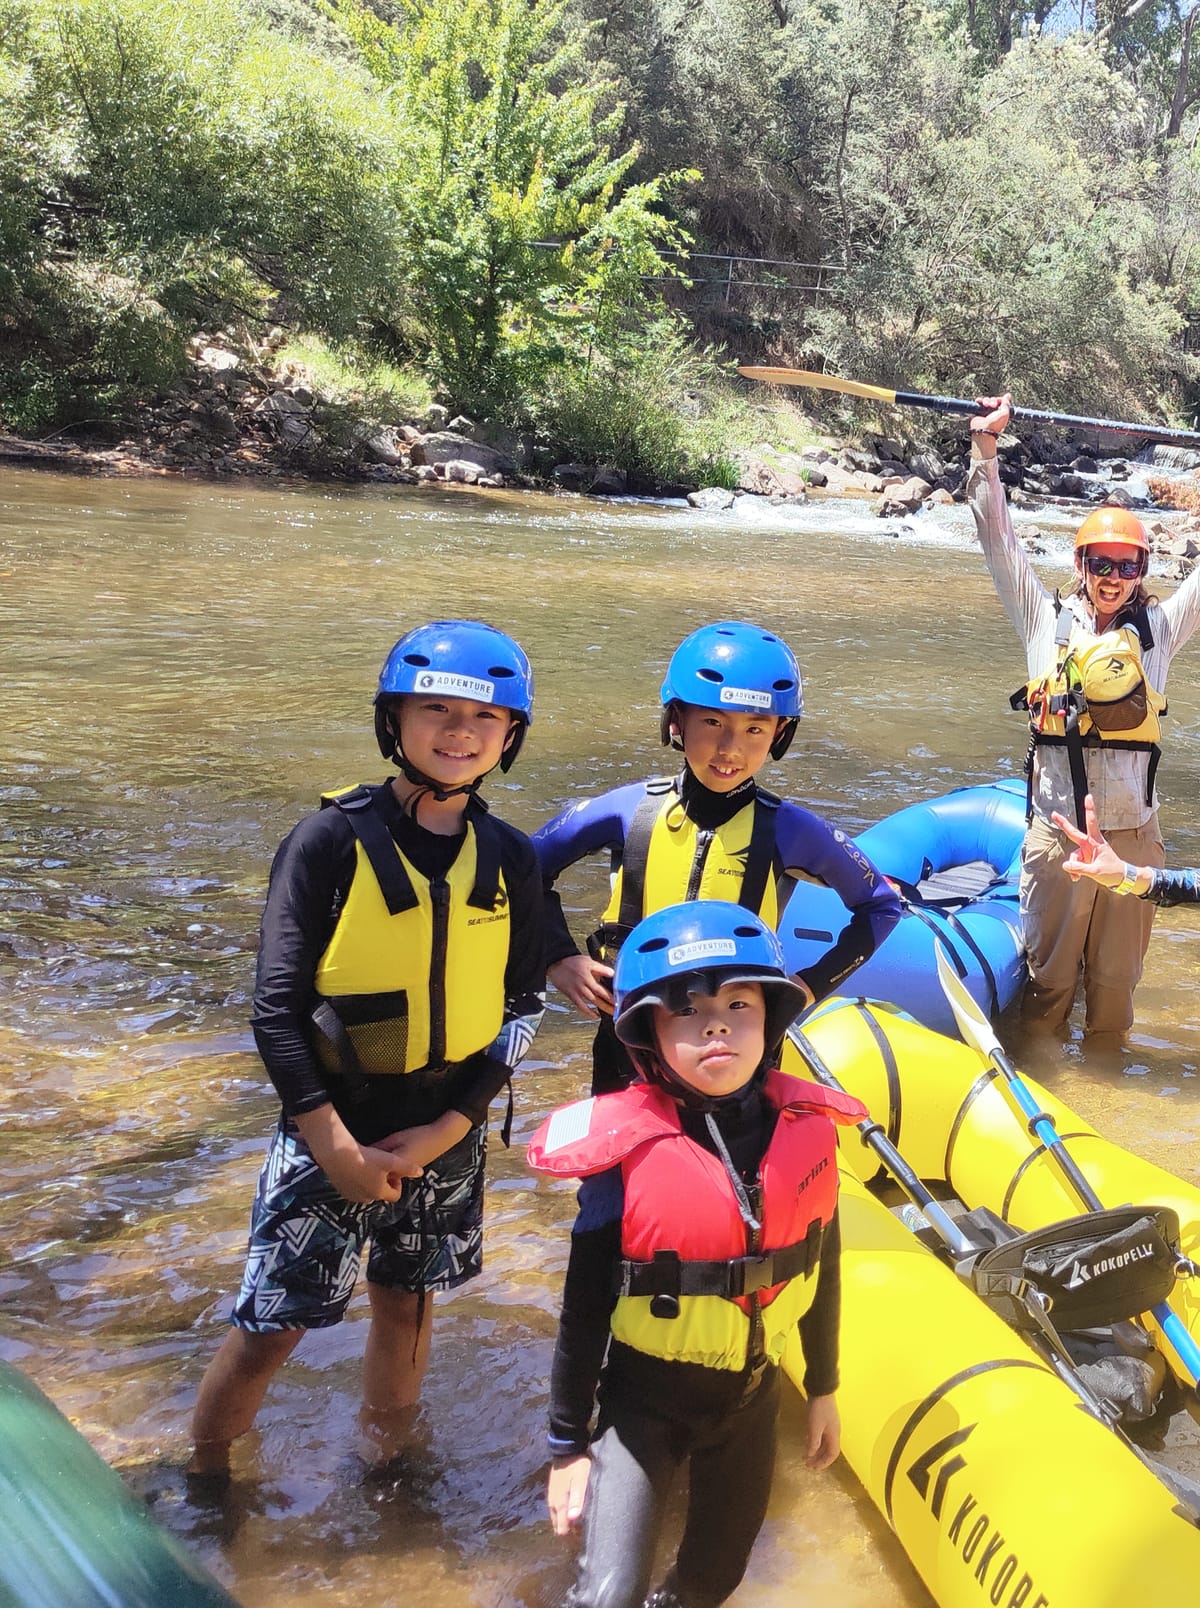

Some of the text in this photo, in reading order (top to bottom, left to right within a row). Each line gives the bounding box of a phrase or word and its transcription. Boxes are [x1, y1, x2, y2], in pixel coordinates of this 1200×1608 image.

[436, 676, 492, 694] ADVENTURE
[735, 691, 770, 702] ADVENTURE
[687, 942, 733, 953] ADVENTURE
[798, 1156, 828, 1196] arlin
